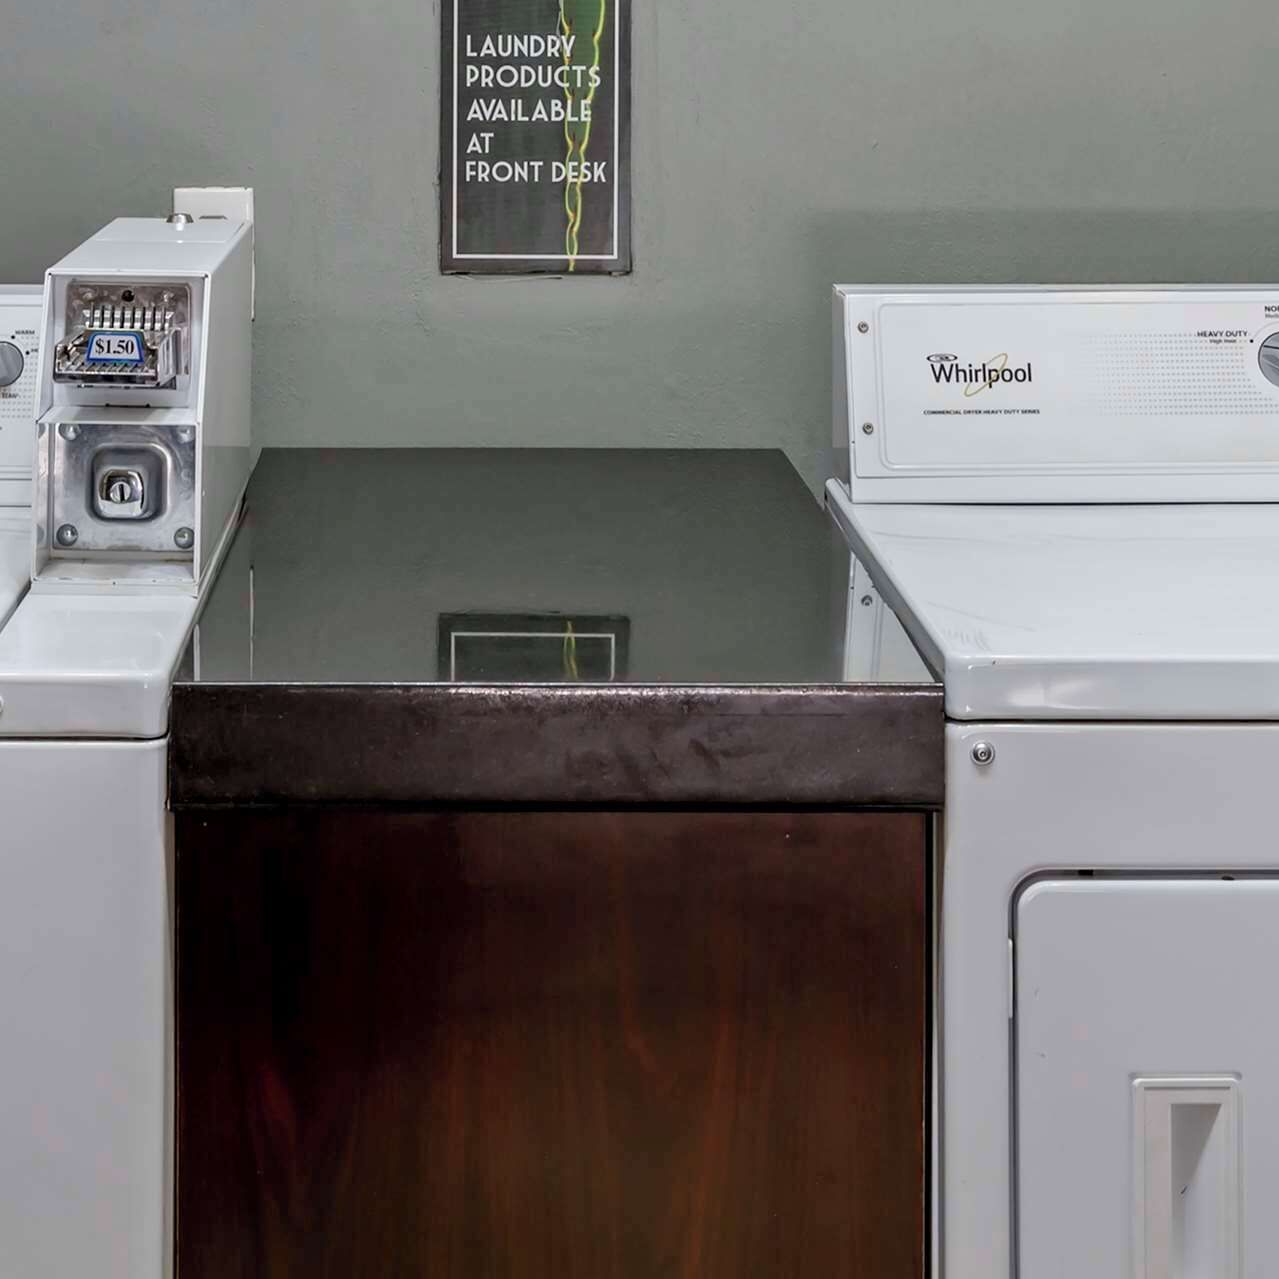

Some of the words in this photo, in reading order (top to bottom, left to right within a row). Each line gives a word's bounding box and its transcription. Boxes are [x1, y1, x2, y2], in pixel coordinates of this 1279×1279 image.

[466, 34, 576, 57] LAUNDRY
[466, 65, 601, 88] PRODUCTS
[466, 99, 591, 121] AVAILABLE
[466, 132, 494, 154] AT
[465, 161, 543, 182] FRONT
[551, 161, 607, 182] DESK
[95, 338, 134, 355] $1.50
[930, 363, 1032, 388] Whirlpool
